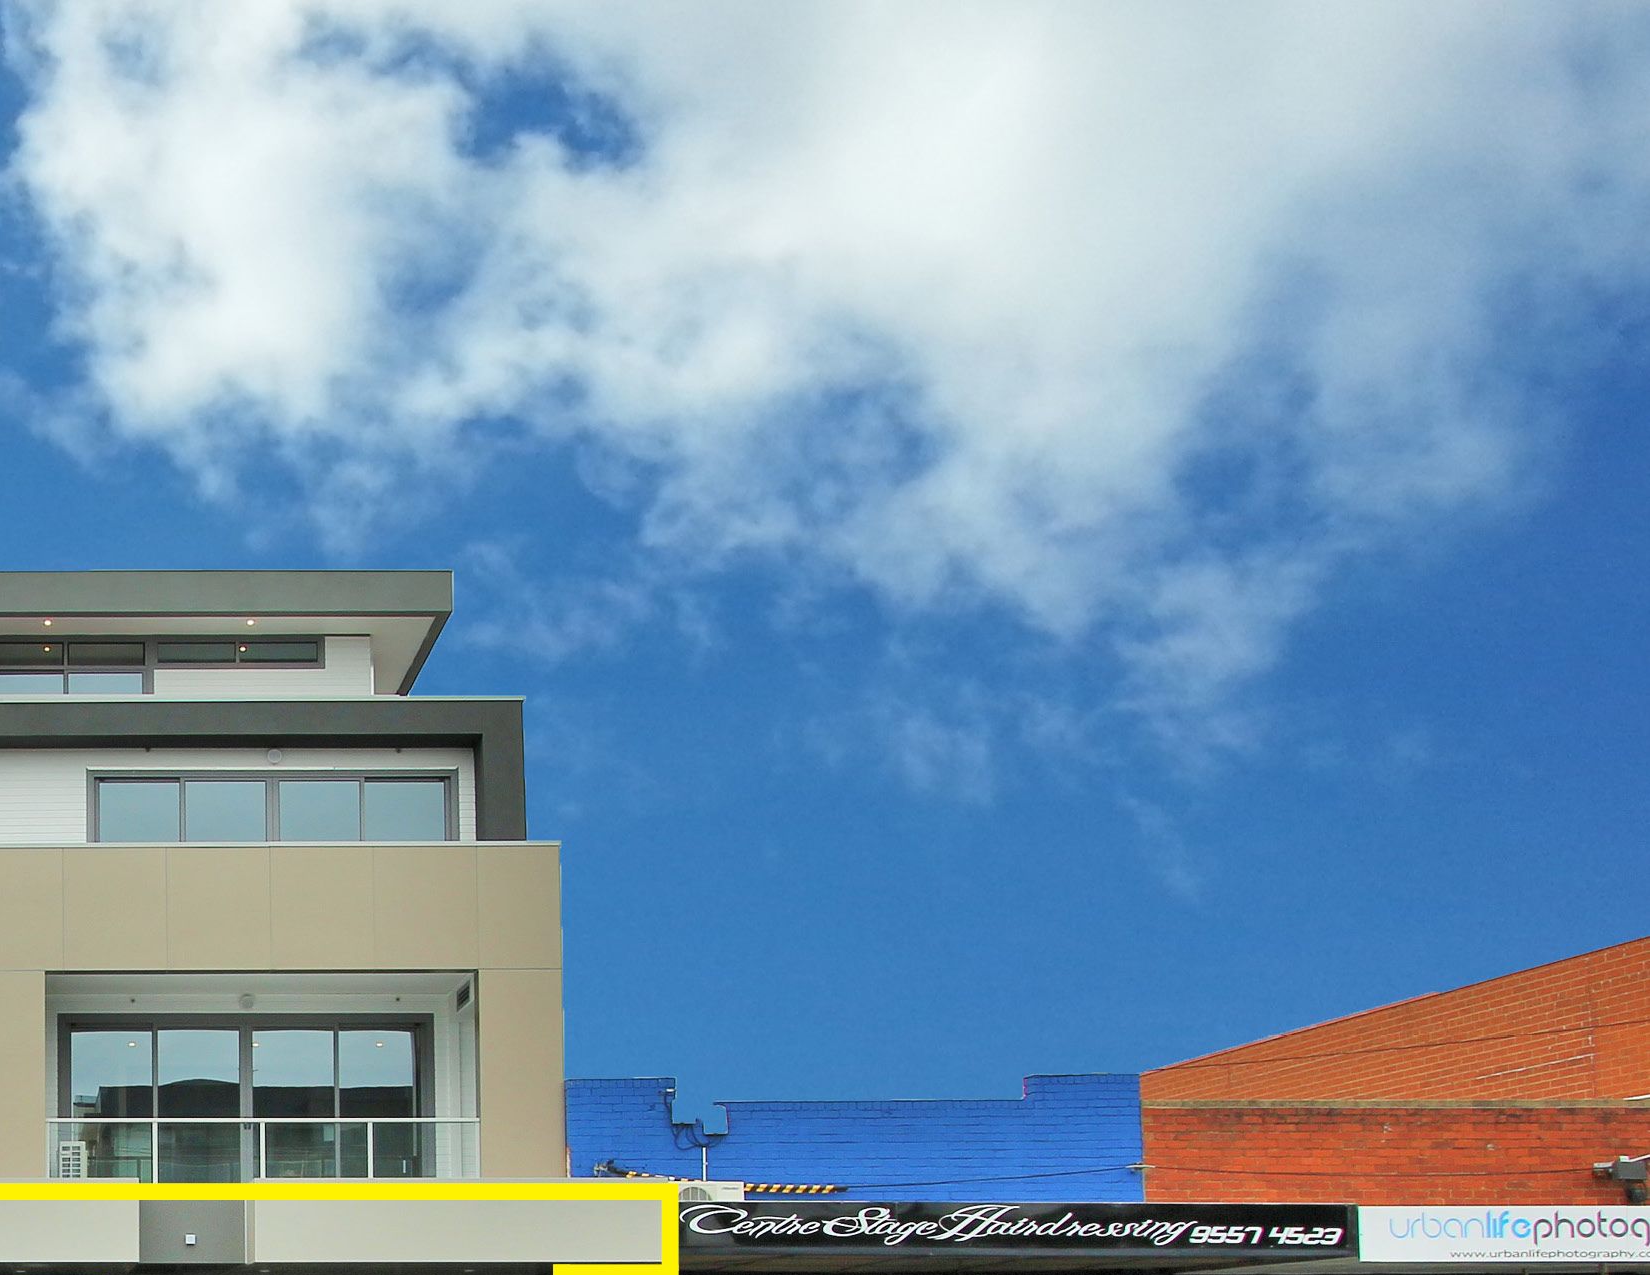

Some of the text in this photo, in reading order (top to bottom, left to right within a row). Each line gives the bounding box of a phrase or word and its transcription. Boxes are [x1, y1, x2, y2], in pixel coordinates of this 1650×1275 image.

[680, 1204, 1344, 1245] Centre Stage Hairdressing 9557 4523
[1389, 1209, 1650, 1247] urbanlifephotog
[1450, 1249, 1650, 1260] www.urbanlifephotography.co
